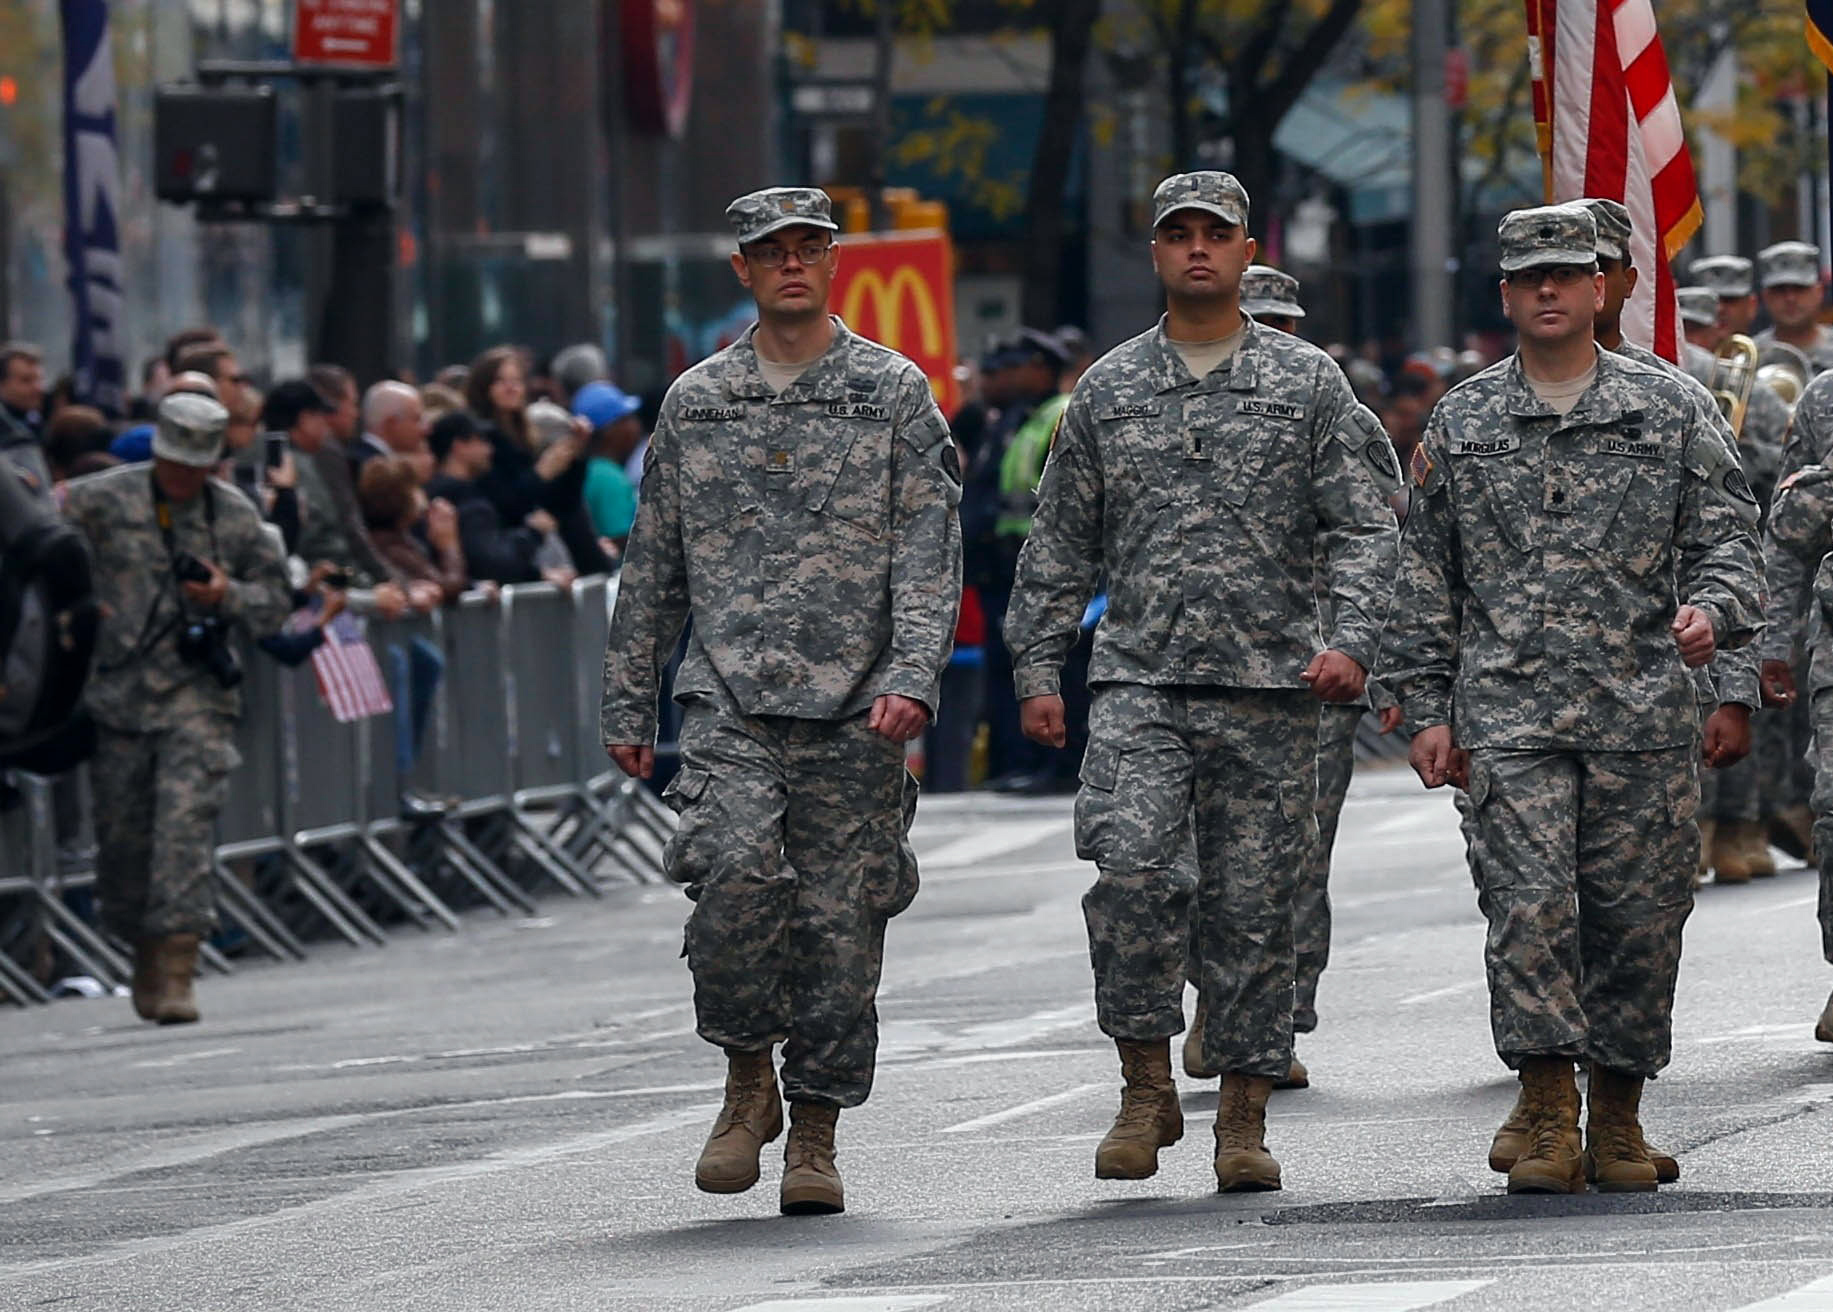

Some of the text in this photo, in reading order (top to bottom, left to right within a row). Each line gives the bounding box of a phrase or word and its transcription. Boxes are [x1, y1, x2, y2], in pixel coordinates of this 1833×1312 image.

[852, 405, 886, 419] ARMY
[1243, 401, 1297, 417] U.S. ARMY
[1628, 443, 1661, 457] ARMY
